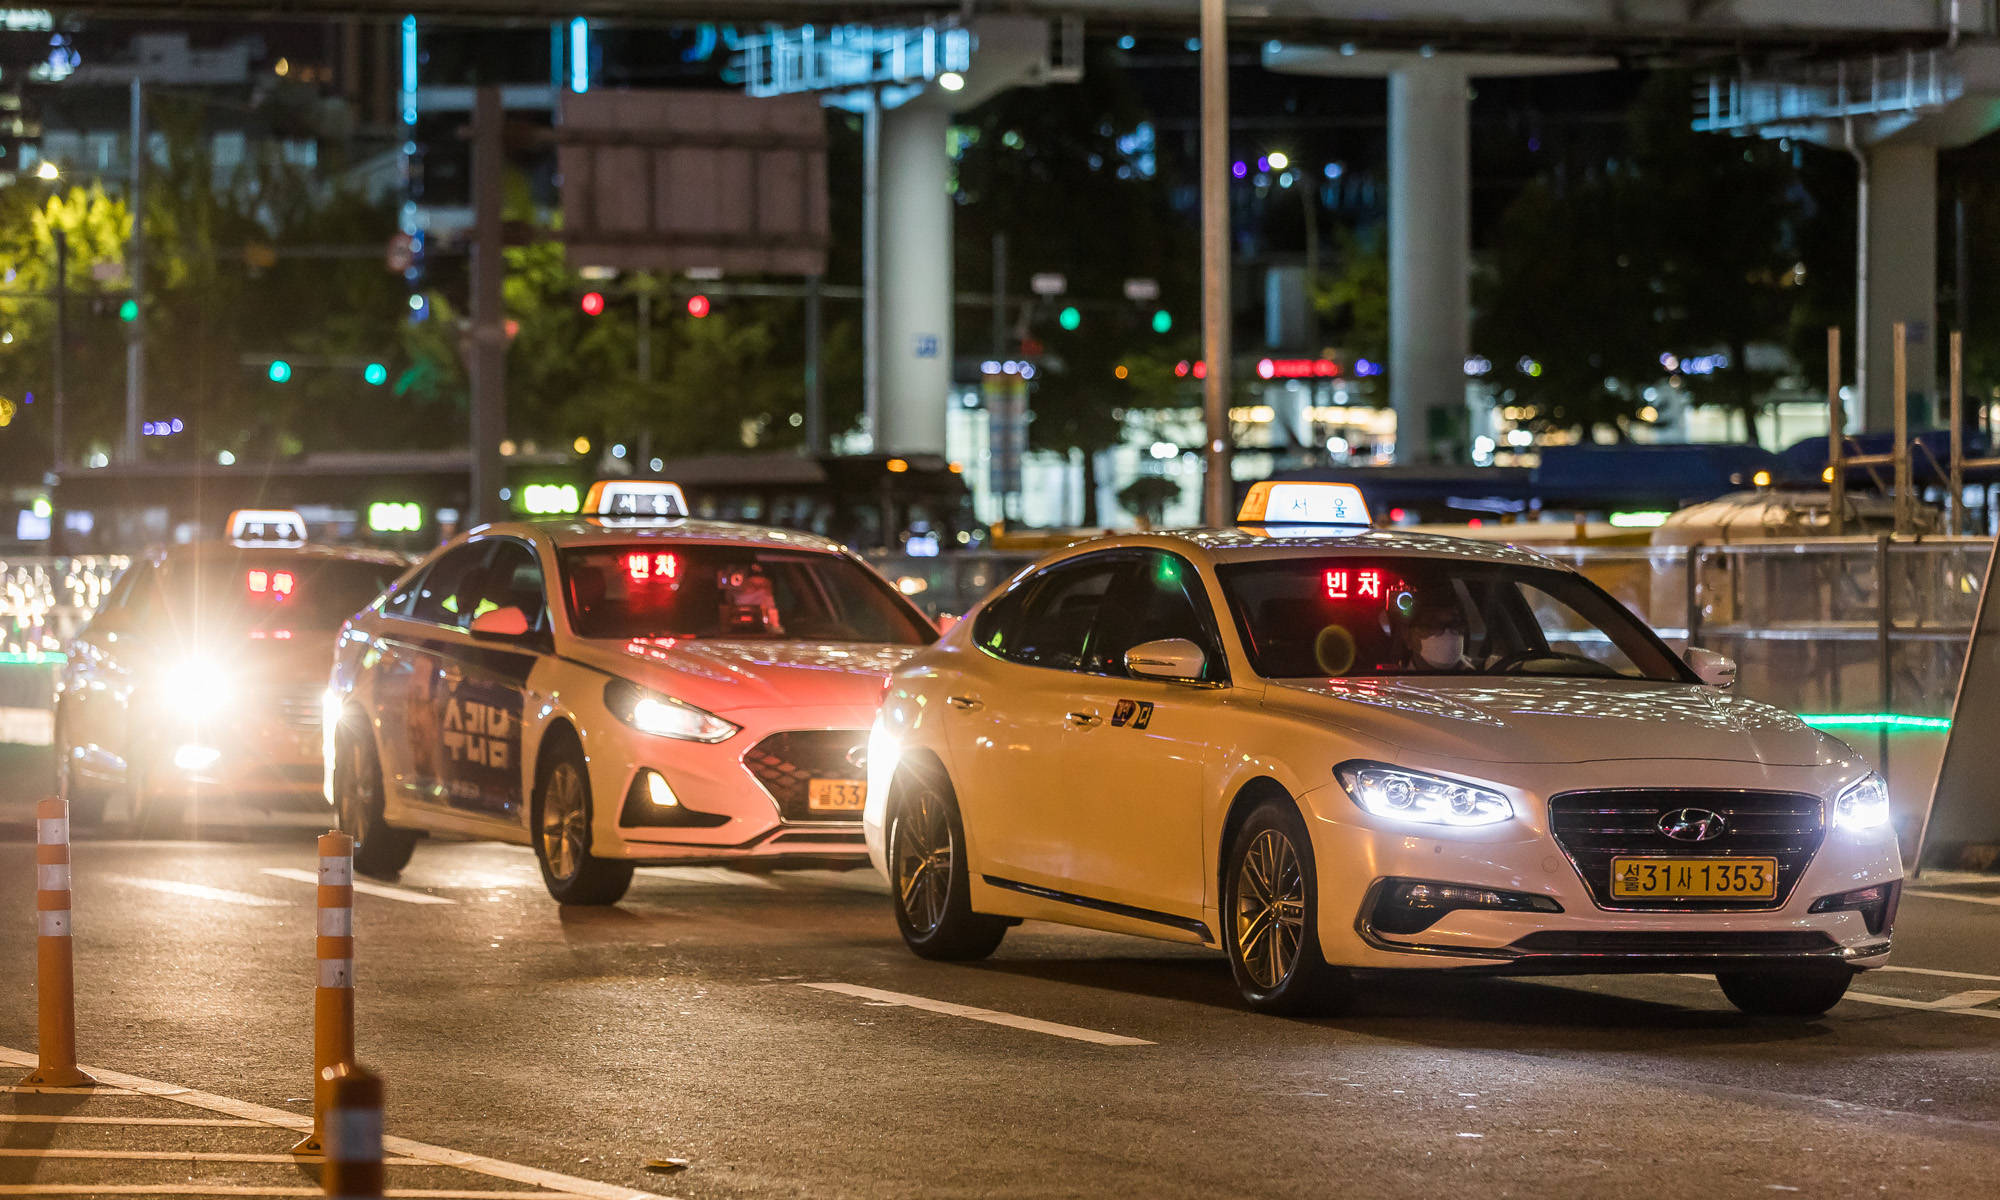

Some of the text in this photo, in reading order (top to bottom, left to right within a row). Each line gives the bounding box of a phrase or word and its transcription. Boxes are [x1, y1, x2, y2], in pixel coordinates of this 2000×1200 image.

[1292, 498, 1348, 519] 서울
[628, 555, 677, 578] 빈차
[1326, 571, 1381, 598] 빈차
[1623, 864, 1640, 892] 서울
[1701, 865, 1765, 892] 1353
